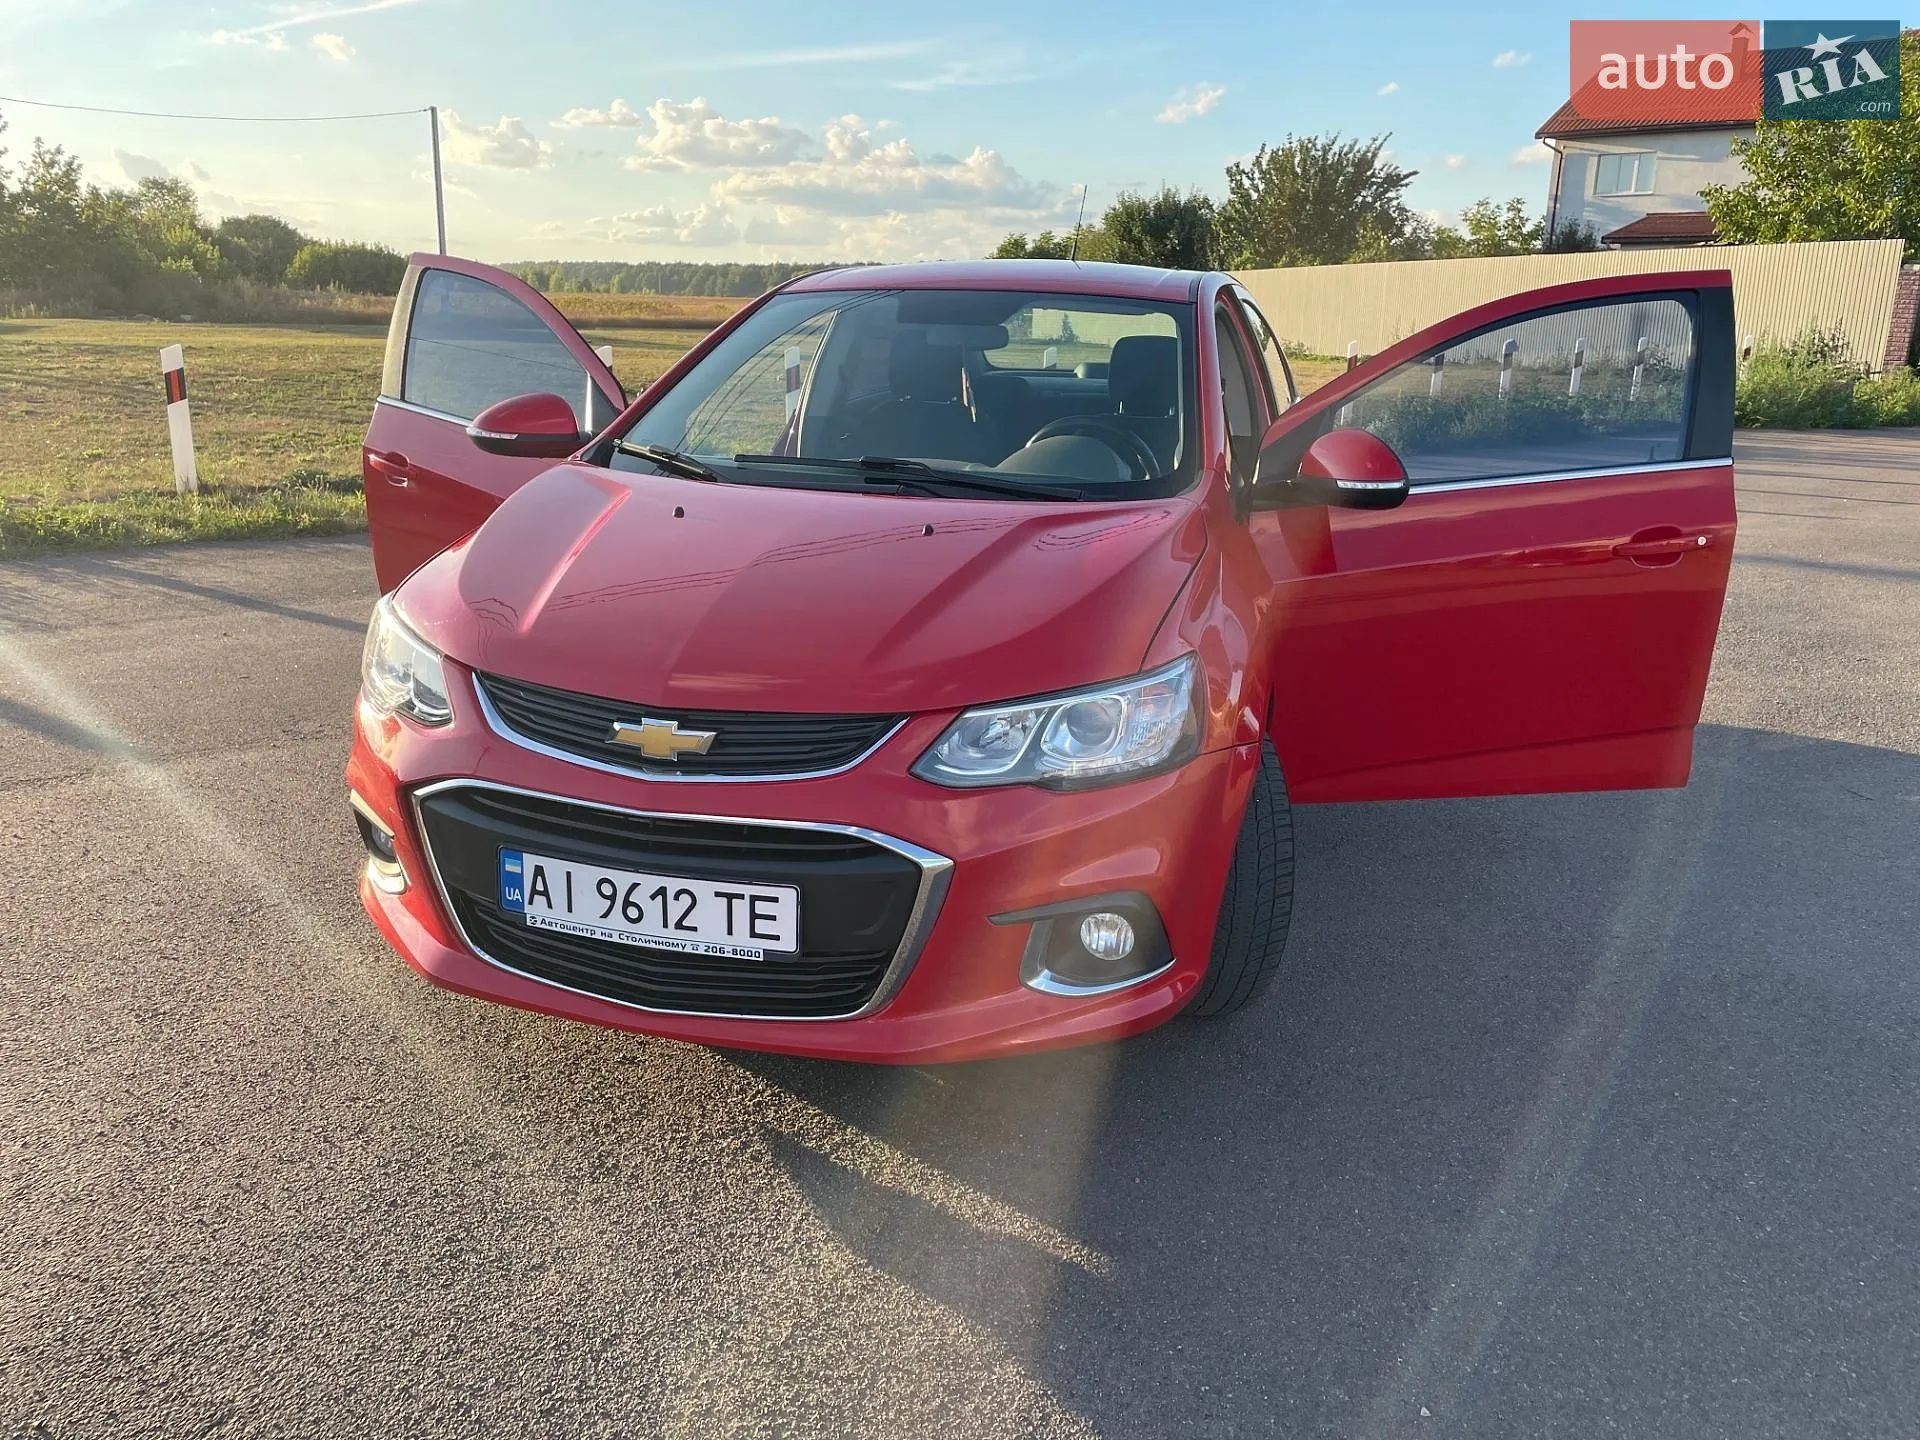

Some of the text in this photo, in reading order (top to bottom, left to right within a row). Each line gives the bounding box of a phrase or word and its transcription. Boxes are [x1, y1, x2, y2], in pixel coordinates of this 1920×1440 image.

[505, 886, 523, 903] UA
[528, 864, 781, 941] AI 9612 TE
[539, 917, 761, 960] Автоцентр на Столичному 206-8000
